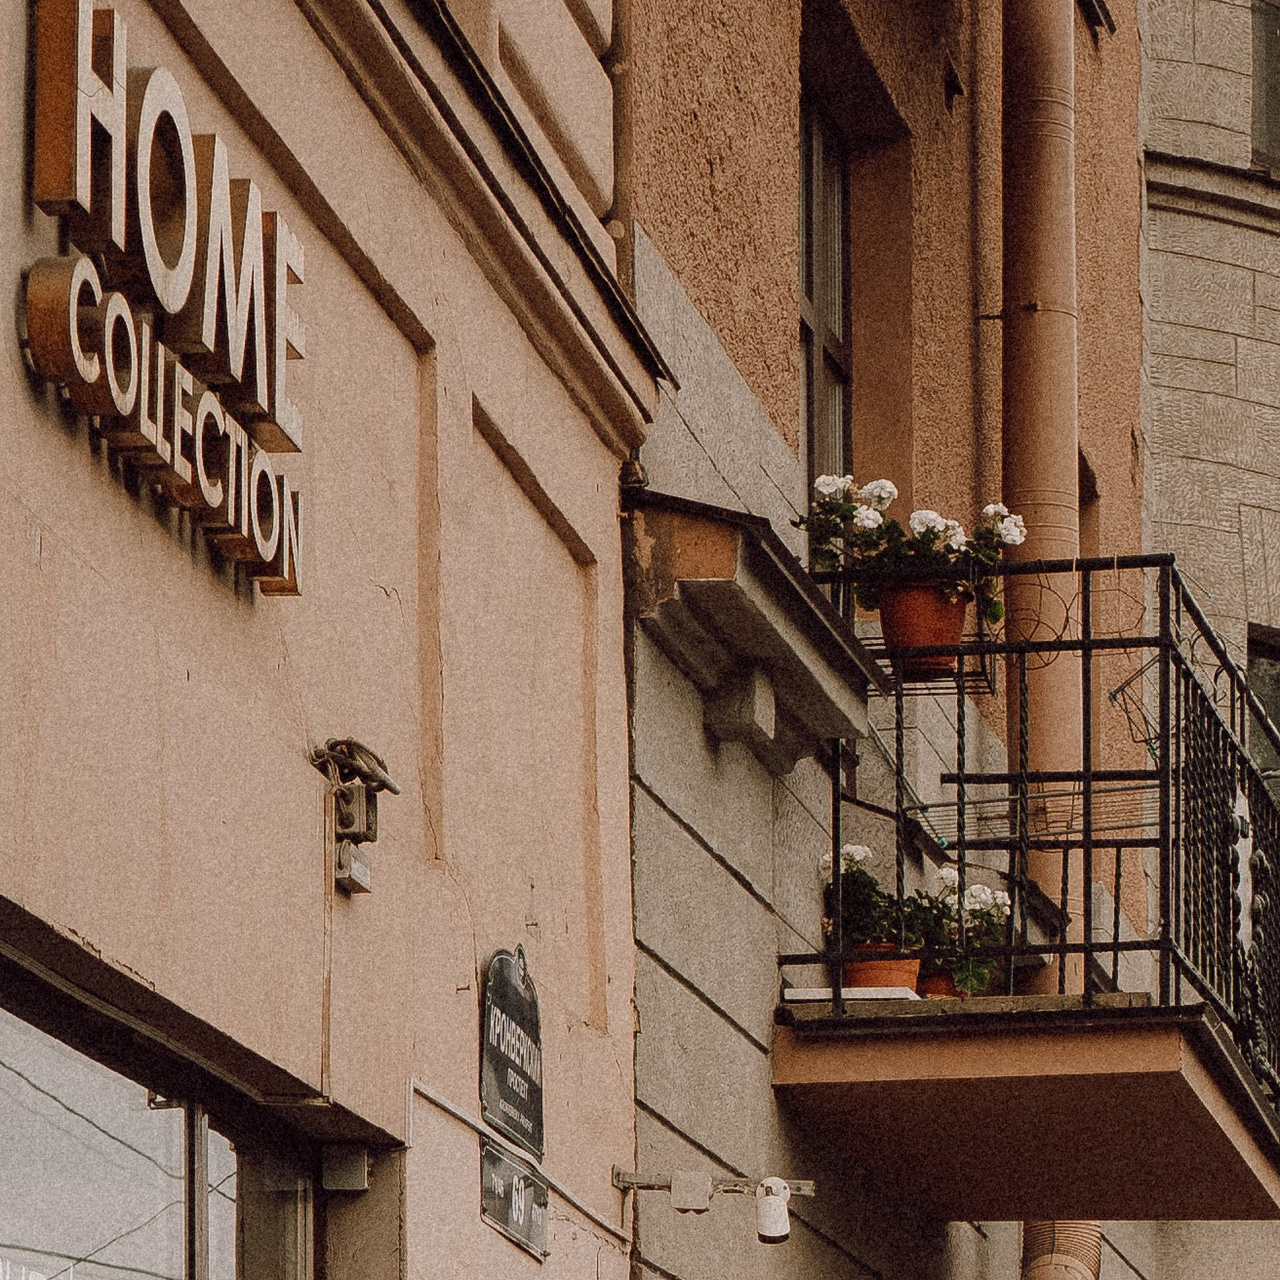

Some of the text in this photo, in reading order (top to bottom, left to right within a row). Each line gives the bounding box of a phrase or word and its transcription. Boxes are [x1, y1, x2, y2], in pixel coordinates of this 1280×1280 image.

[76, 0, 304, 453] HOME
[69, 256, 302, 596] COLLECTION
[512, 1175, 525, 1226] 69
